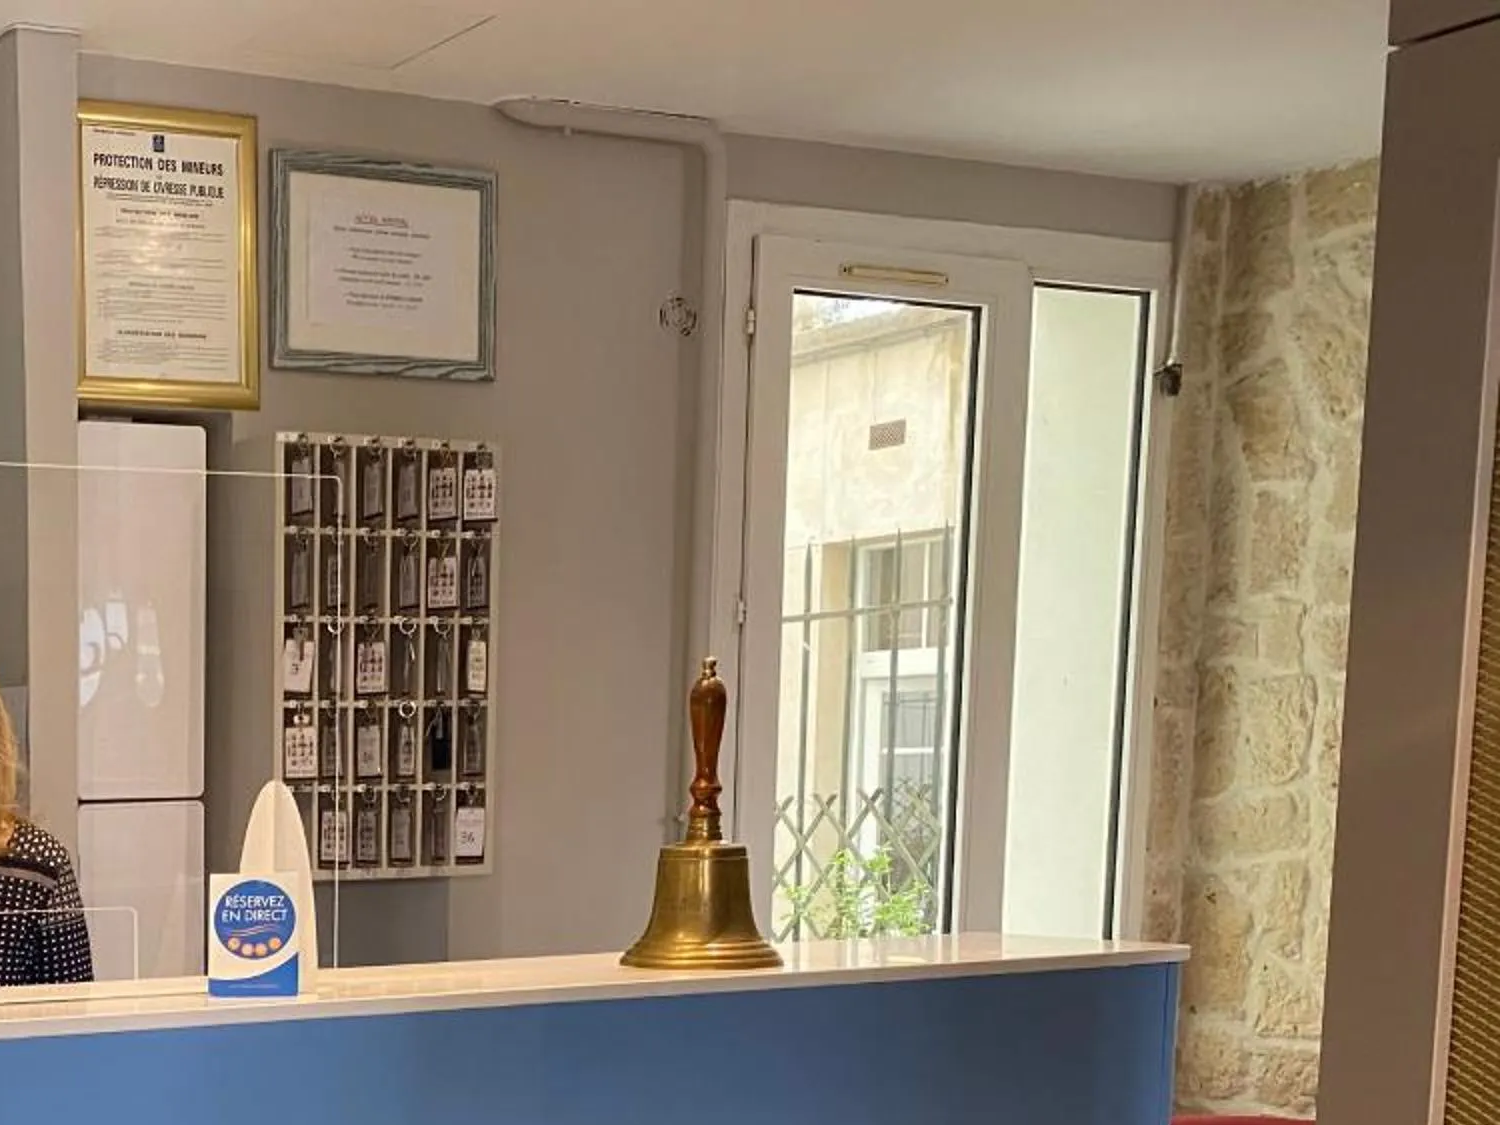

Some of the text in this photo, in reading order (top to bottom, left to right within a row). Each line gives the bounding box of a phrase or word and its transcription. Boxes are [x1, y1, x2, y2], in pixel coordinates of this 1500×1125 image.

[93, 153, 223, 176] PROTECTION DES MINEURS
[189, 184, 225, 199] PUBLIQUE
[225, 894, 285, 908] RÉSERVEZ
[221, 908, 289, 923] EN DIRECT
